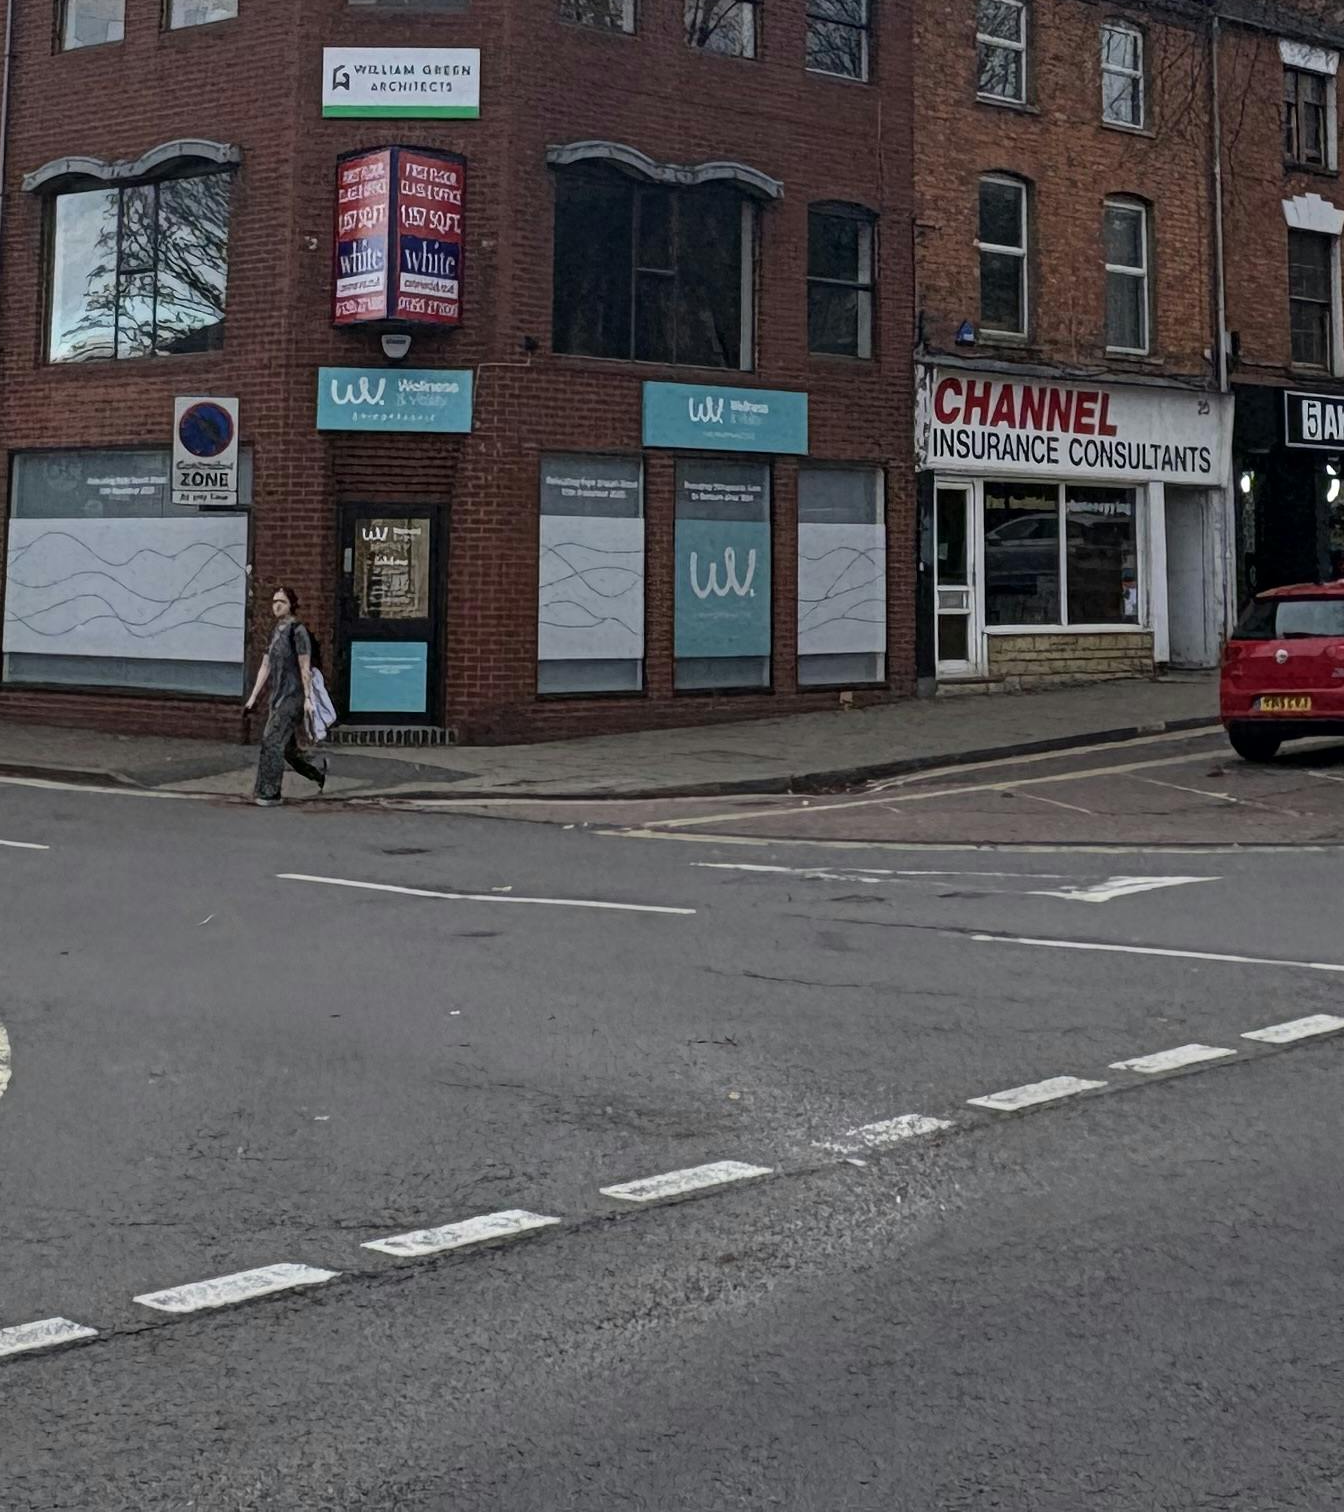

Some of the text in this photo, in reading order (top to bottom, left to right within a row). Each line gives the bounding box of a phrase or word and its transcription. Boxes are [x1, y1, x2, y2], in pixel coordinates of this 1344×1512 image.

[341, 239, 383, 275] white
[405, 240, 455, 277] white
[934, 377, 1118, 437] CHANNEL
[933, 428, 1211, 473] INSURANCE CONSULTANTS
[180, 472, 229, 487] ZONE
